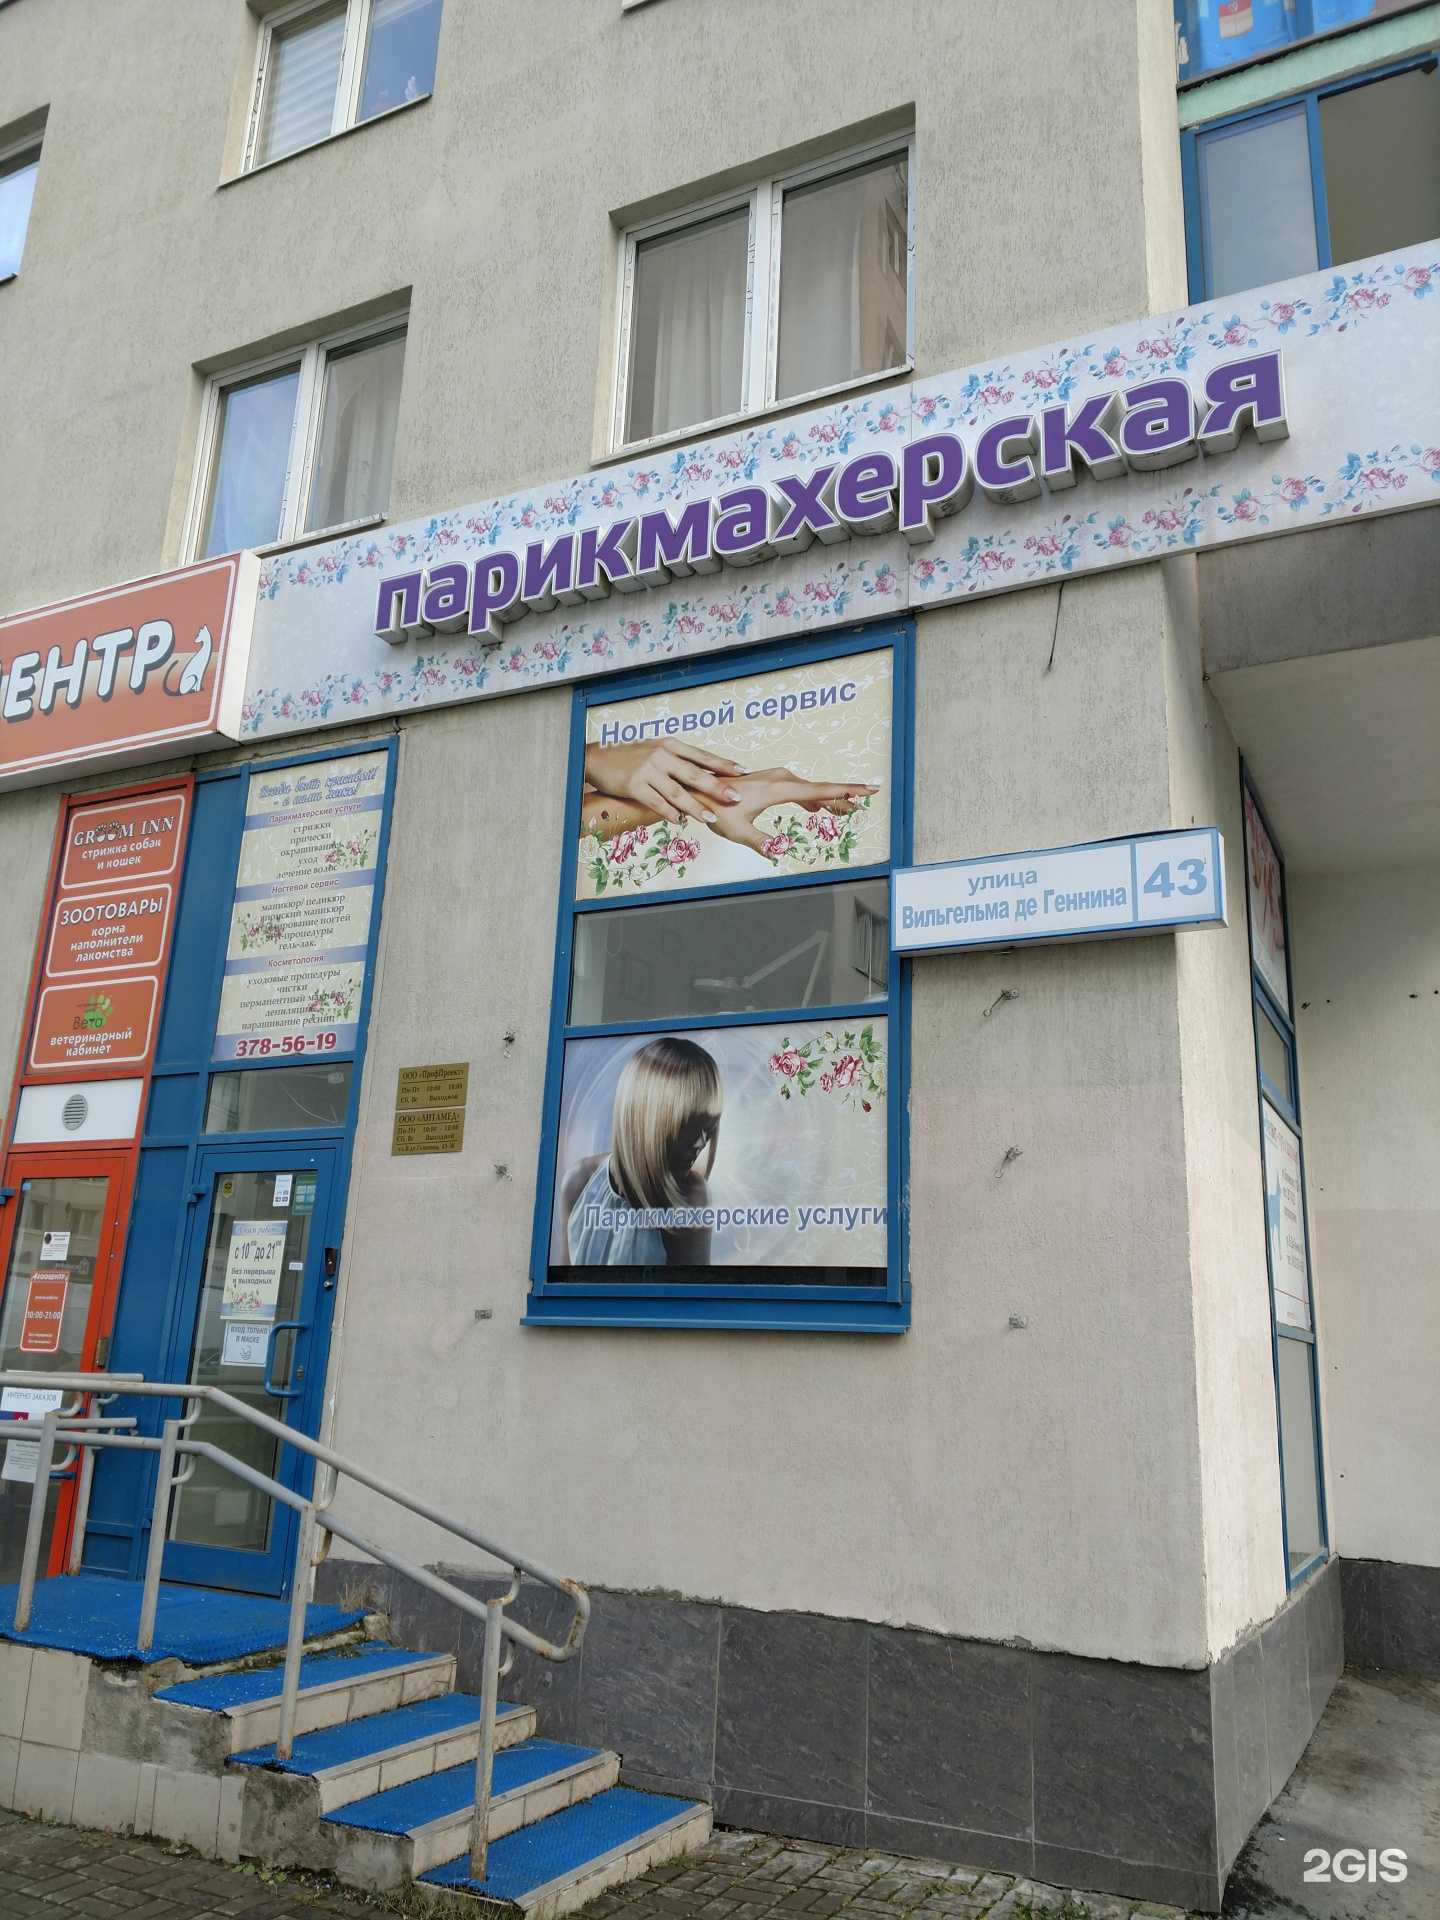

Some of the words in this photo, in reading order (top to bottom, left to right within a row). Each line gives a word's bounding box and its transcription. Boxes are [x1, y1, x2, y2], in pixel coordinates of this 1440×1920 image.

[374, 350, 1289, 646] парикмахерская
[0, 618, 176, 723] ЕНТР
[600, 700, 735, 746] Ногтевой
[744, 681, 857, 721] сервис
[141, 816, 176, 835] INN
[82, 845, 128, 860] стрижка
[129, 837, 162, 851] собак
[106, 855, 142, 868] кошек
[968, 867, 1038, 897] улица
[1143, 858, 1208, 898] 43
[60, 896, 163, 926] ЗООТОВАРЫ
[902, 901, 1010, 930] Вильгельма
[1015, 897, 1037, 922] де
[1043, 886, 1127, 915] Геннина
[91, 924, 126, 937] корма
[70, 934, 144, 951] наполнители
[75, 948, 134, 963] лакомства
[268, 955, 325, 967] Косметология
[49, 1028, 133, 1046] ветеринарный
[235, 1033, 337, 1057] 378-56-19
[66, 1044, 112, 1057] кабинет
[584, 1205, 790, 1231] Парикмахерские
[797, 1207, 888, 1231] услуги
[253, 1247, 265, 1262] до
